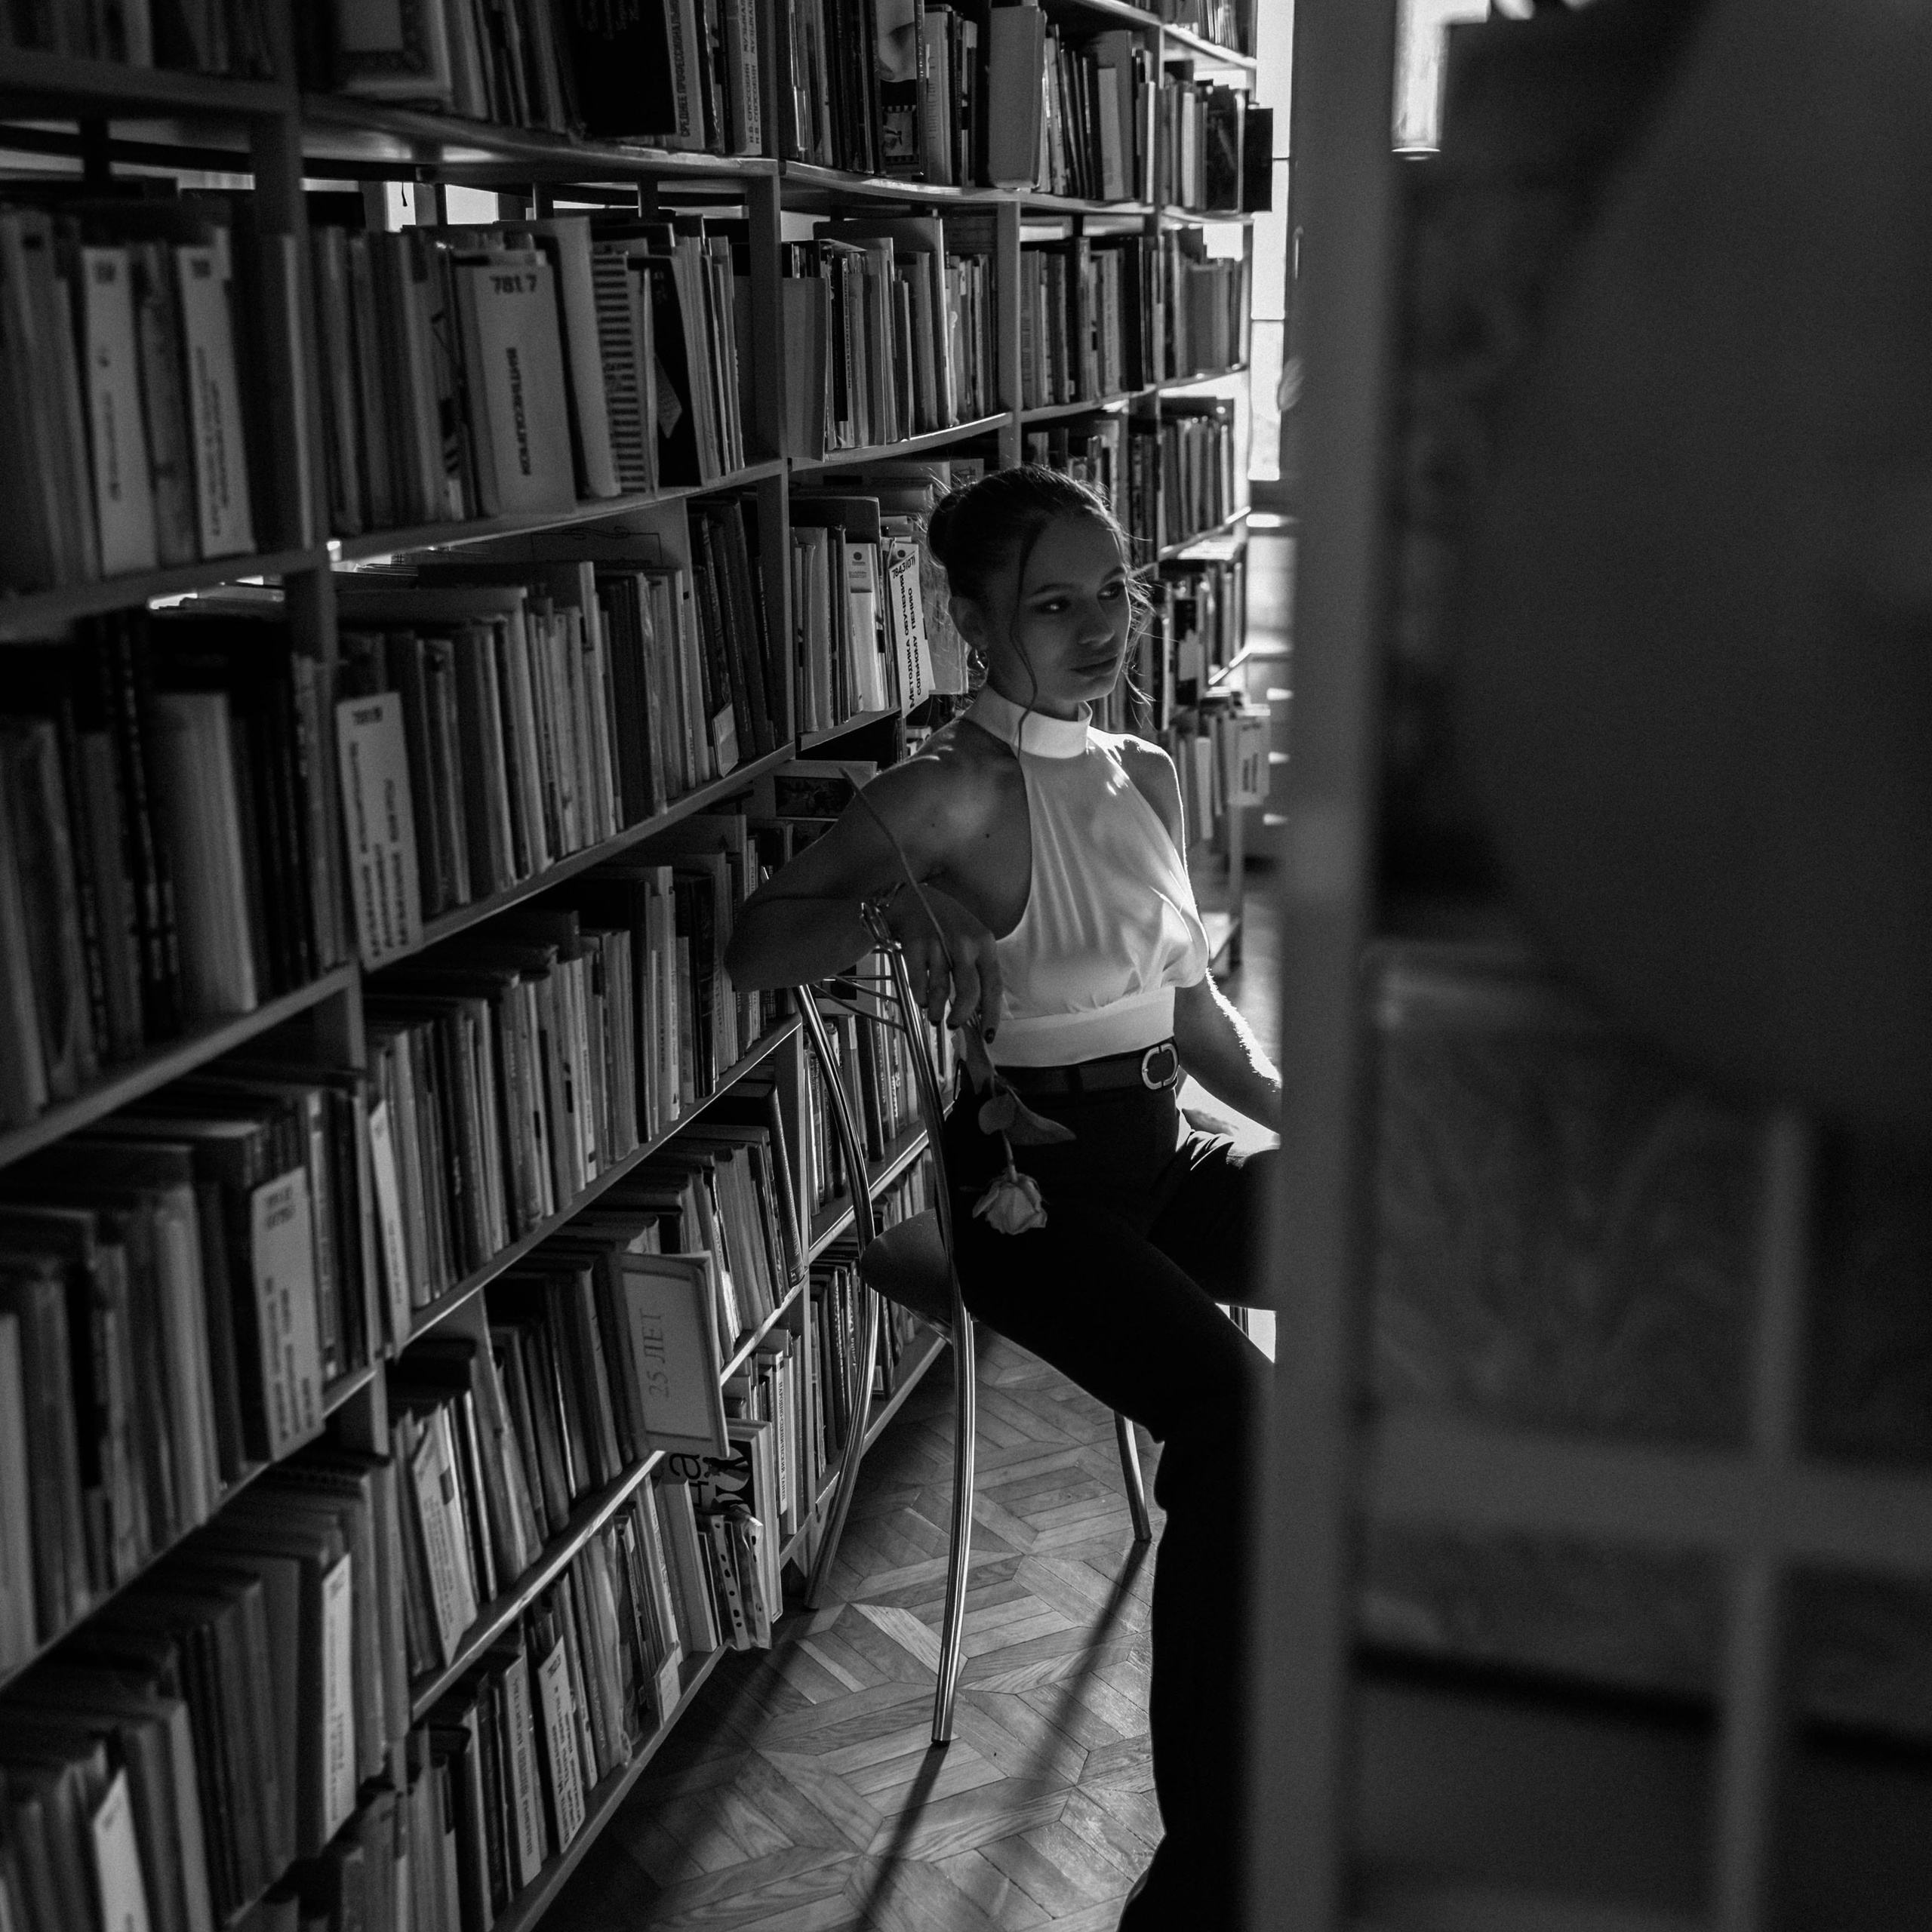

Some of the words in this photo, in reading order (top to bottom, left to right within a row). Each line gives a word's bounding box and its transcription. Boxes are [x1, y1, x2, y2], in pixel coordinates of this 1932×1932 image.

[900, 575, 909, 635] ОБУЧЕНИЯ
[908, 588, 916, 629] ПЕНИЮ
[906, 639, 915, 708] МЕТОДИКА
[912, 636, 921, 695] СОЛЬНОМУ
[641, 1314, 663, 1364] ЛЕТ
[648, 1372, 669, 1397] 25
